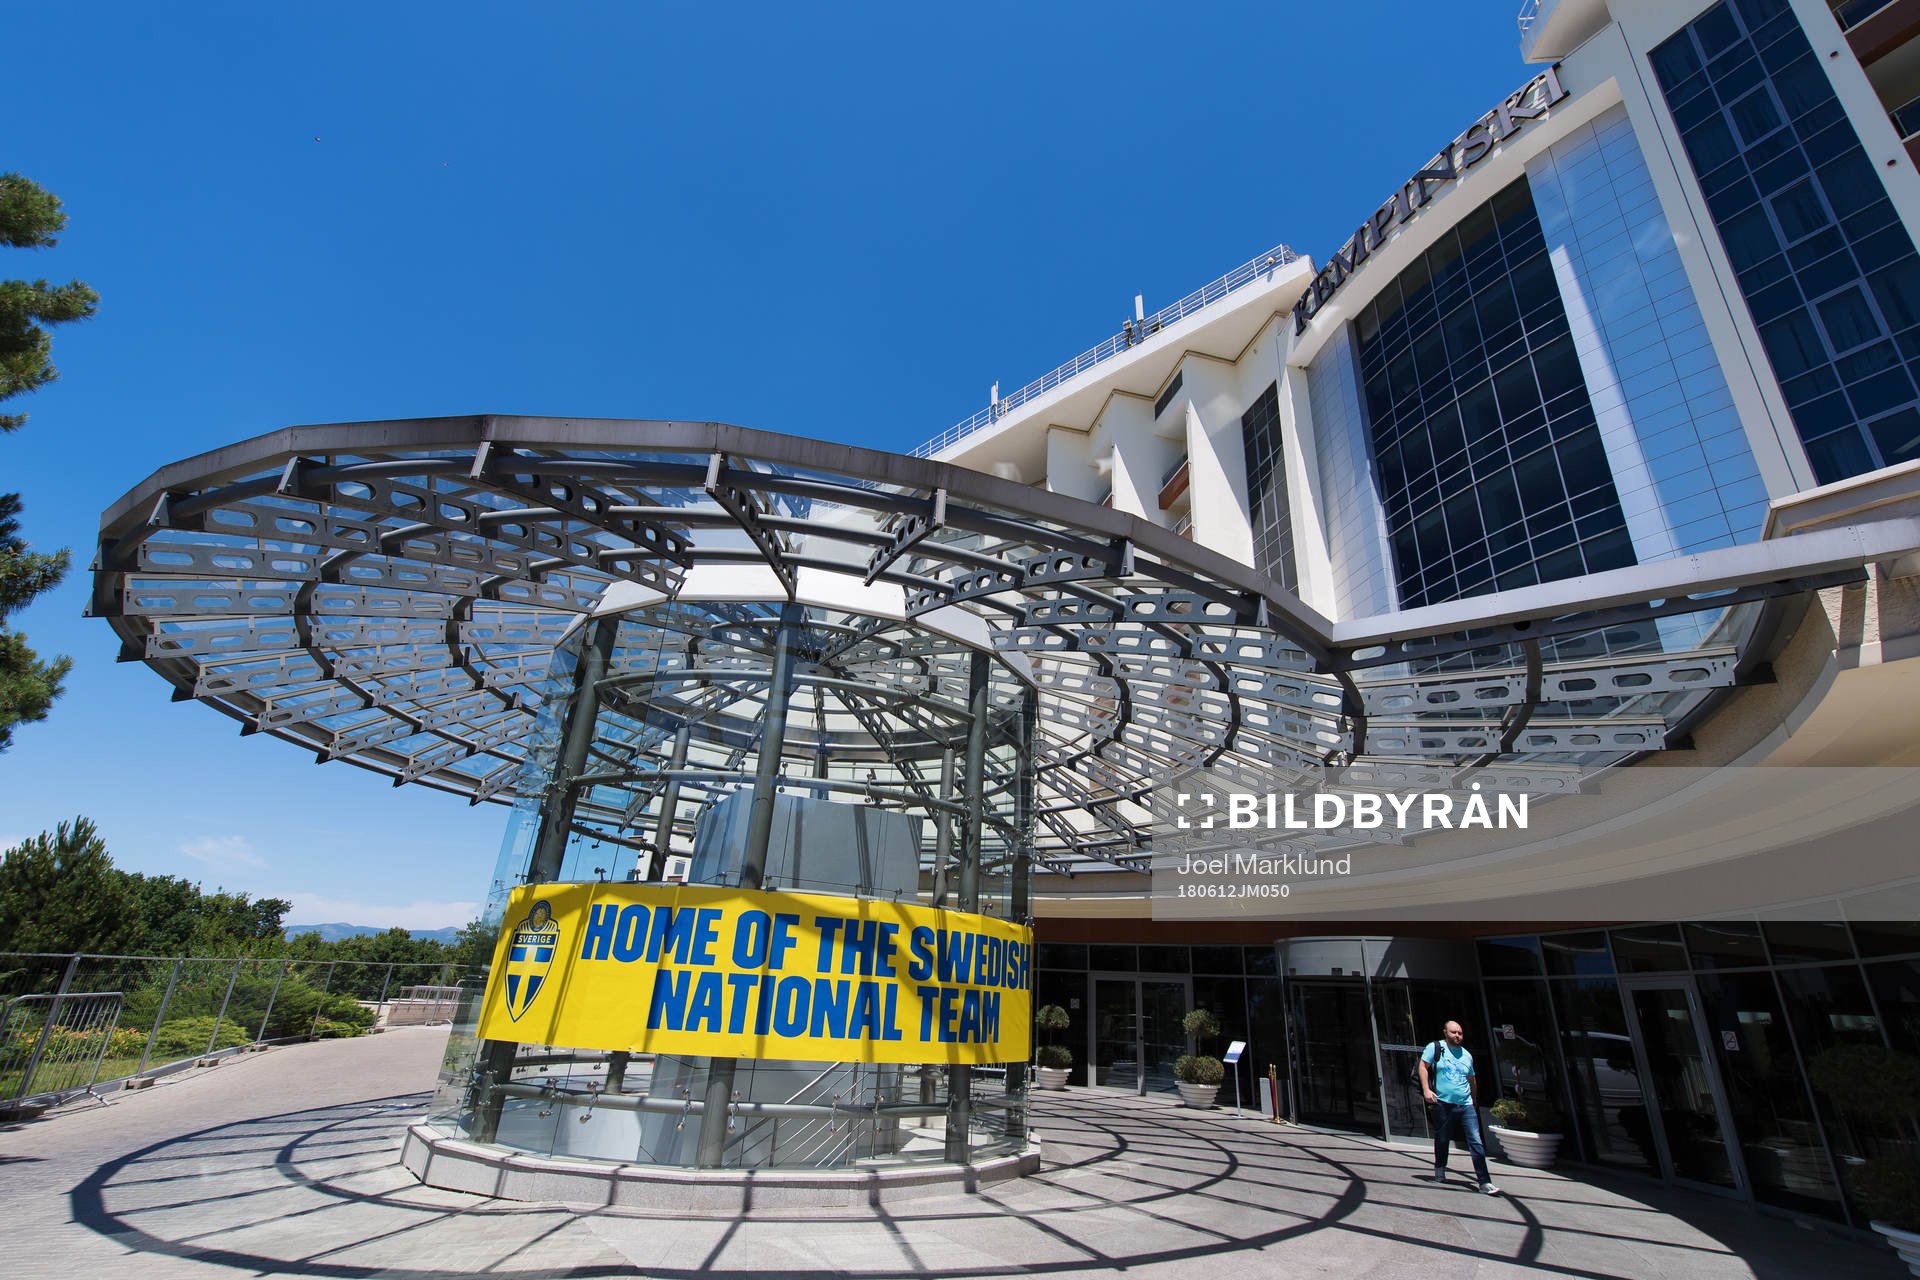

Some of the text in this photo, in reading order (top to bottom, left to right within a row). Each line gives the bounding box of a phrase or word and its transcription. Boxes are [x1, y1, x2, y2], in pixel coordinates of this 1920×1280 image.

[1293, 62, 1570, 336] KEMPINSKI
[517, 934, 552, 944] SVERIGE
[581, 903, 723, 966] HOME
[732, 910, 801, 970] OF
[812, 916, 900, 978] THE
[908, 925, 1031, 990] SWEDISH
[646, 969, 1001, 1044] NATIONAL TEAM
